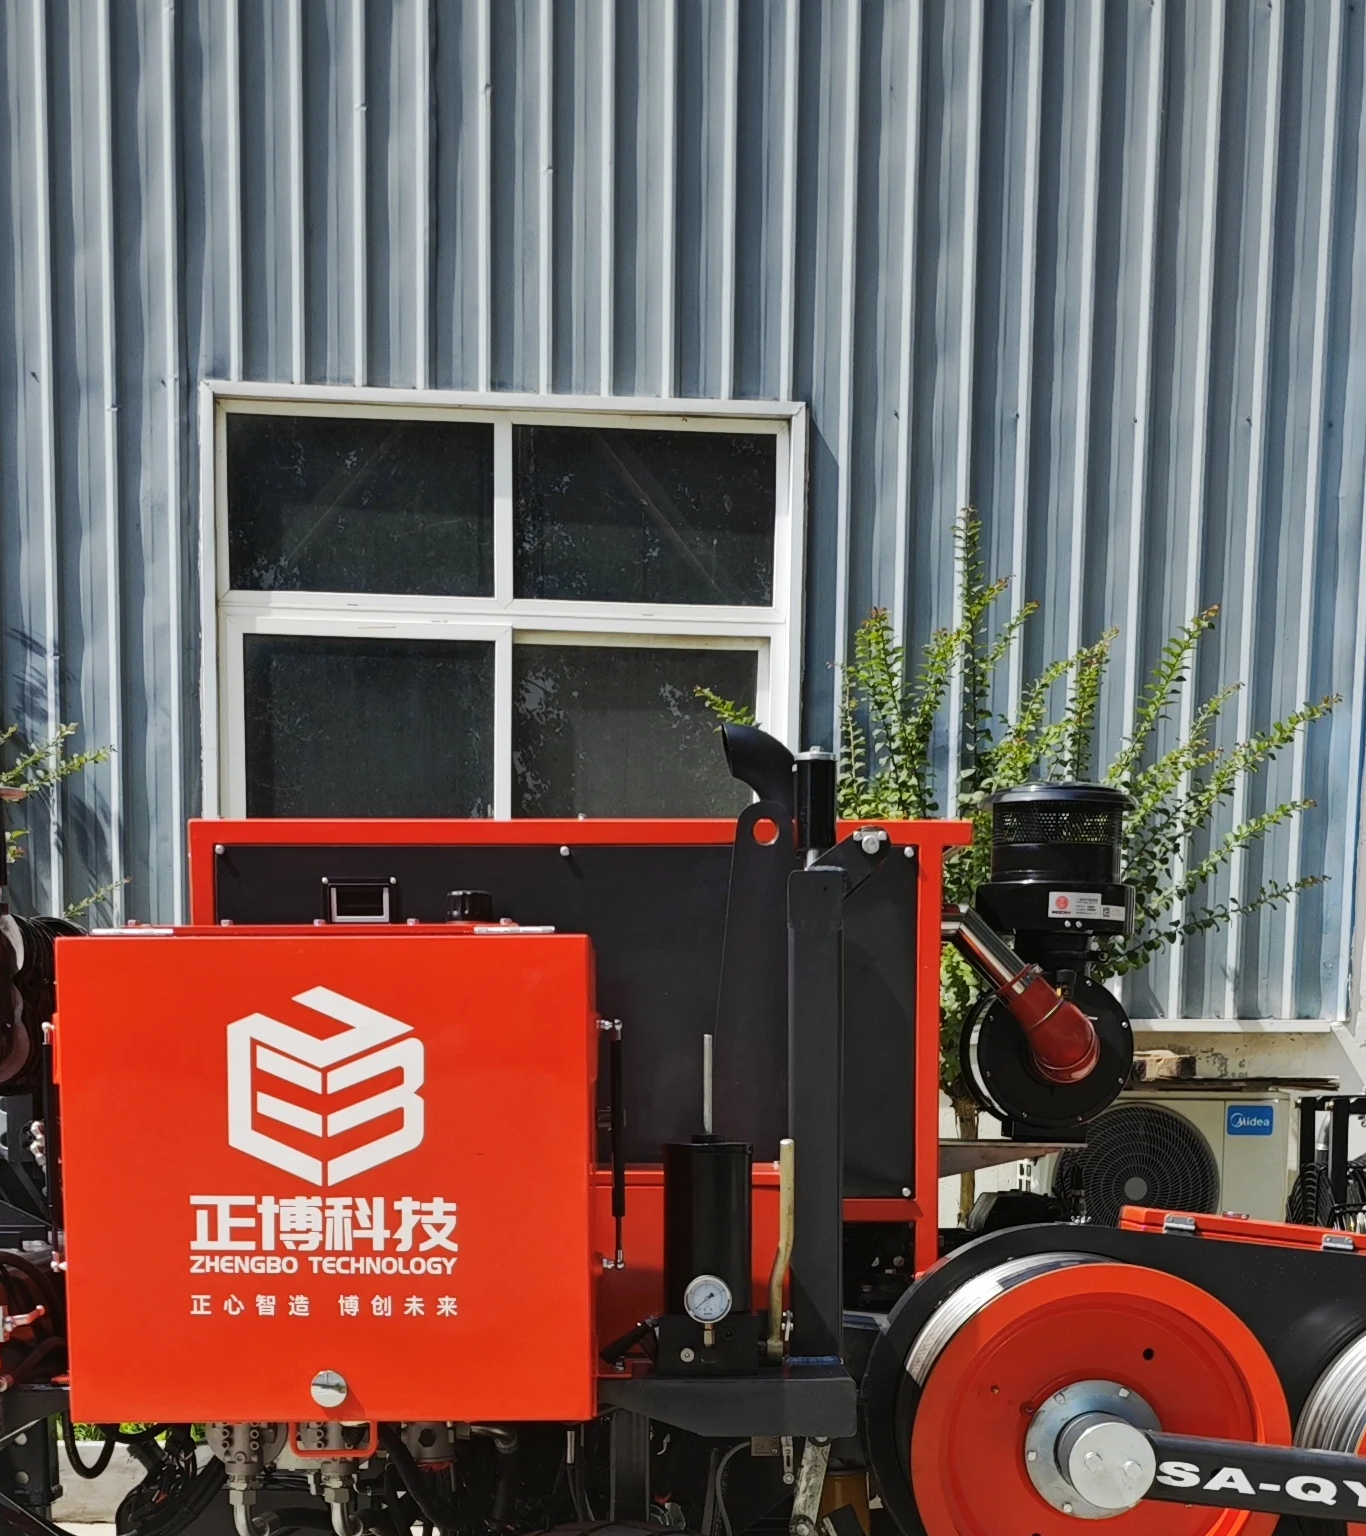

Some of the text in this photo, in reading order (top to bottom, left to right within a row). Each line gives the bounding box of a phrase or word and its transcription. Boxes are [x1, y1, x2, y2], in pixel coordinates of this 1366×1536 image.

[1230, 1112, 1270, 1128] Midea
[189, 1195, 459, 1252] 正博科技
[189, 1255, 457, 1275] ZHENGBO TECHNOLOGY
[190, 1294, 458, 1317] 正心智造 博创未来
